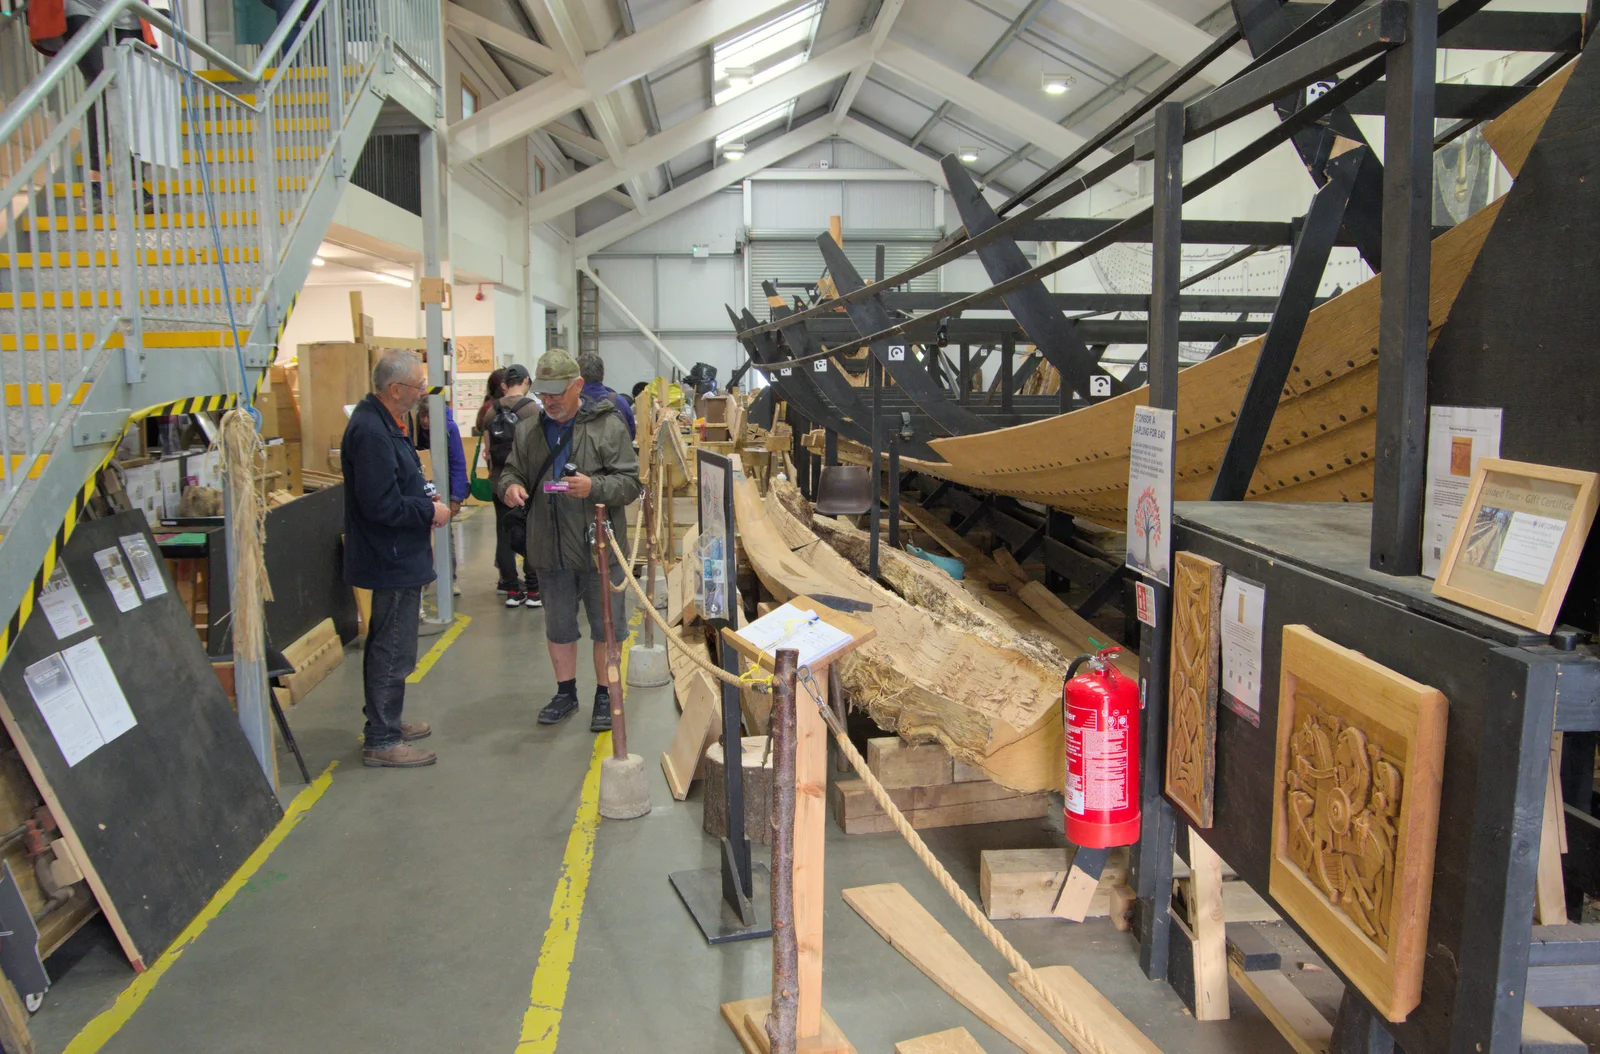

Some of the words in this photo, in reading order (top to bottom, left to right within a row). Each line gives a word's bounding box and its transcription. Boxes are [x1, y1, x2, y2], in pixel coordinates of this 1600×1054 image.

[1134, 425, 1149, 437] SAPLING
[1505, 490, 1520, 501] Tour
[1525, 494, 1540, 504] Gift
[1541, 496, 1574, 512] Certifica
